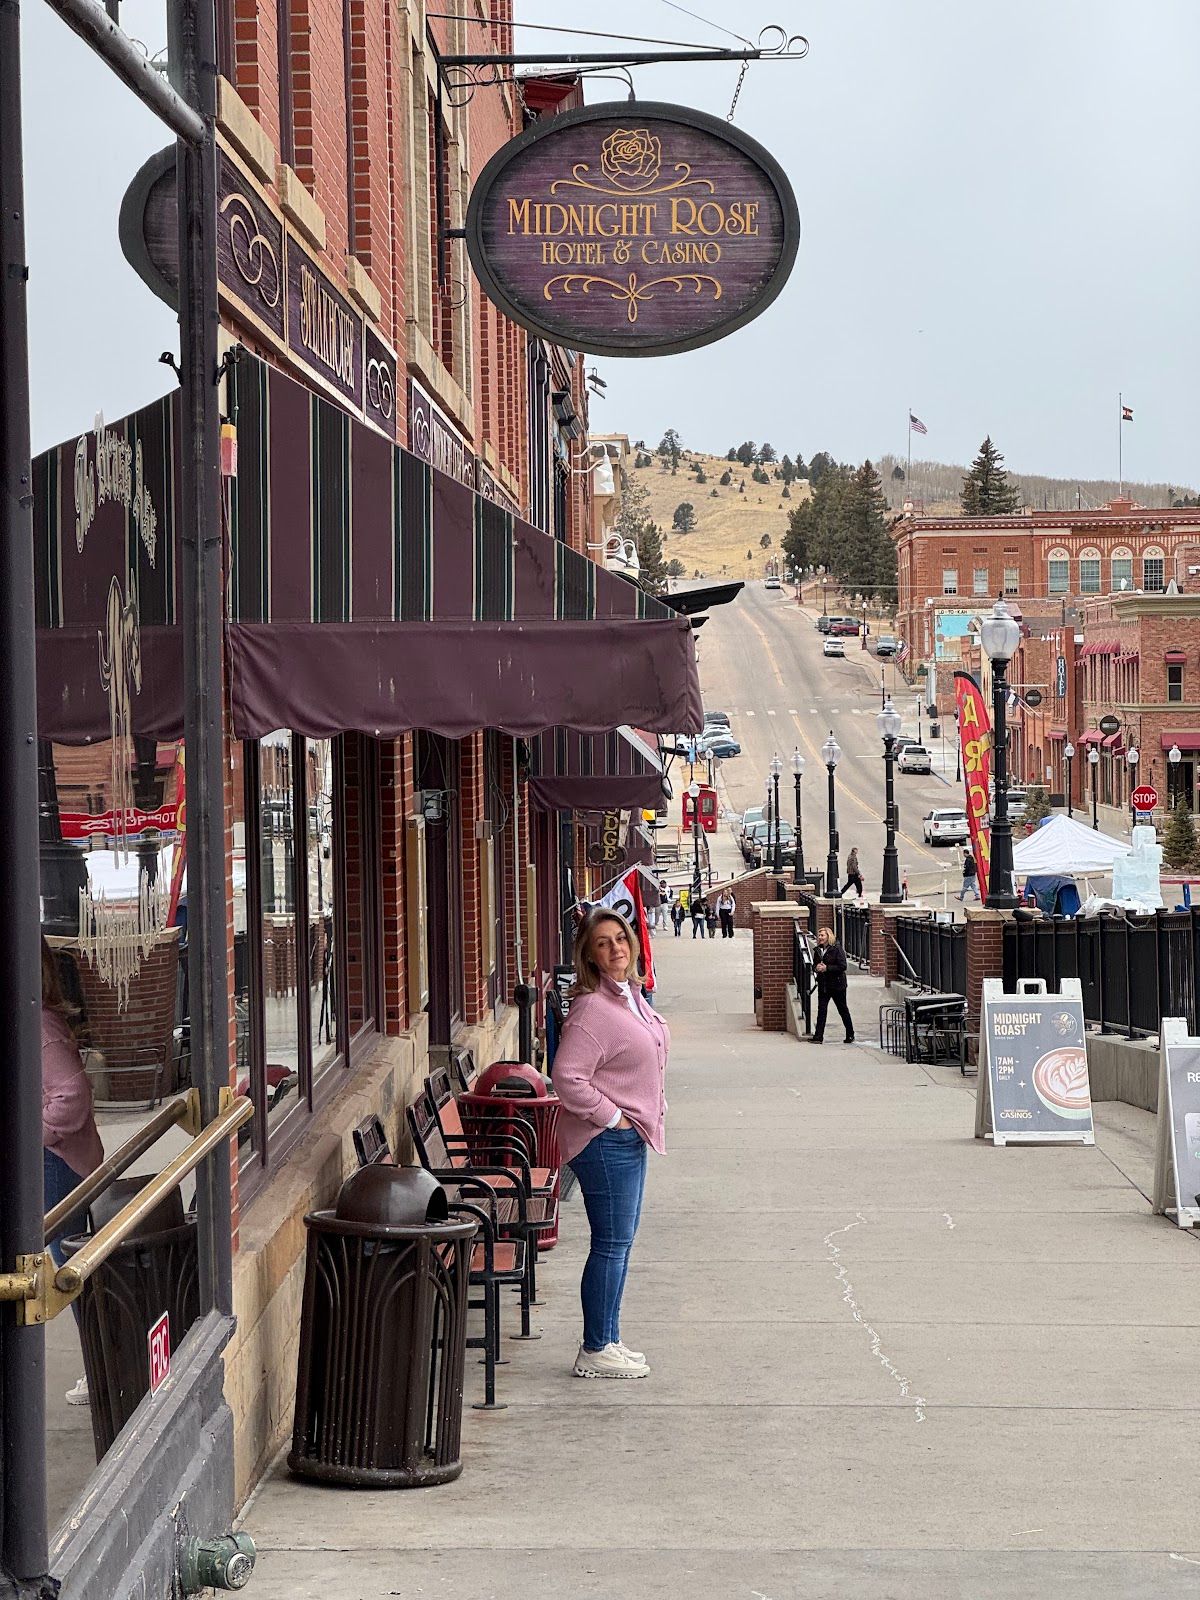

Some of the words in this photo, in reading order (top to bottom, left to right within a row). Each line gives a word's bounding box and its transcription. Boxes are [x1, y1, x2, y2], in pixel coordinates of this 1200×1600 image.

[507, 198, 657, 236] MIDNIGHT
[669, 197, 760, 236] ROSE
[541, 241, 605, 265] HOTEL
[612, 240, 633, 265] &
[641, 241, 722, 265] CASINO
[300, 264, 355, 393] STEAKHOUSE
[1133, 793, 1157, 804] STOP
[602, 808, 620, 862] DGE
[993, 1012, 1042, 1025] MIDNIGHT
[994, 1024, 1027, 1036] ROAST
[997, 1056, 1014, 1065] 7AM
[998, 1065, 1015, 1074] 2PM
[1000, 1111, 1033, 1119] CASINOS
[151, 1324, 168, 1385] FDC
